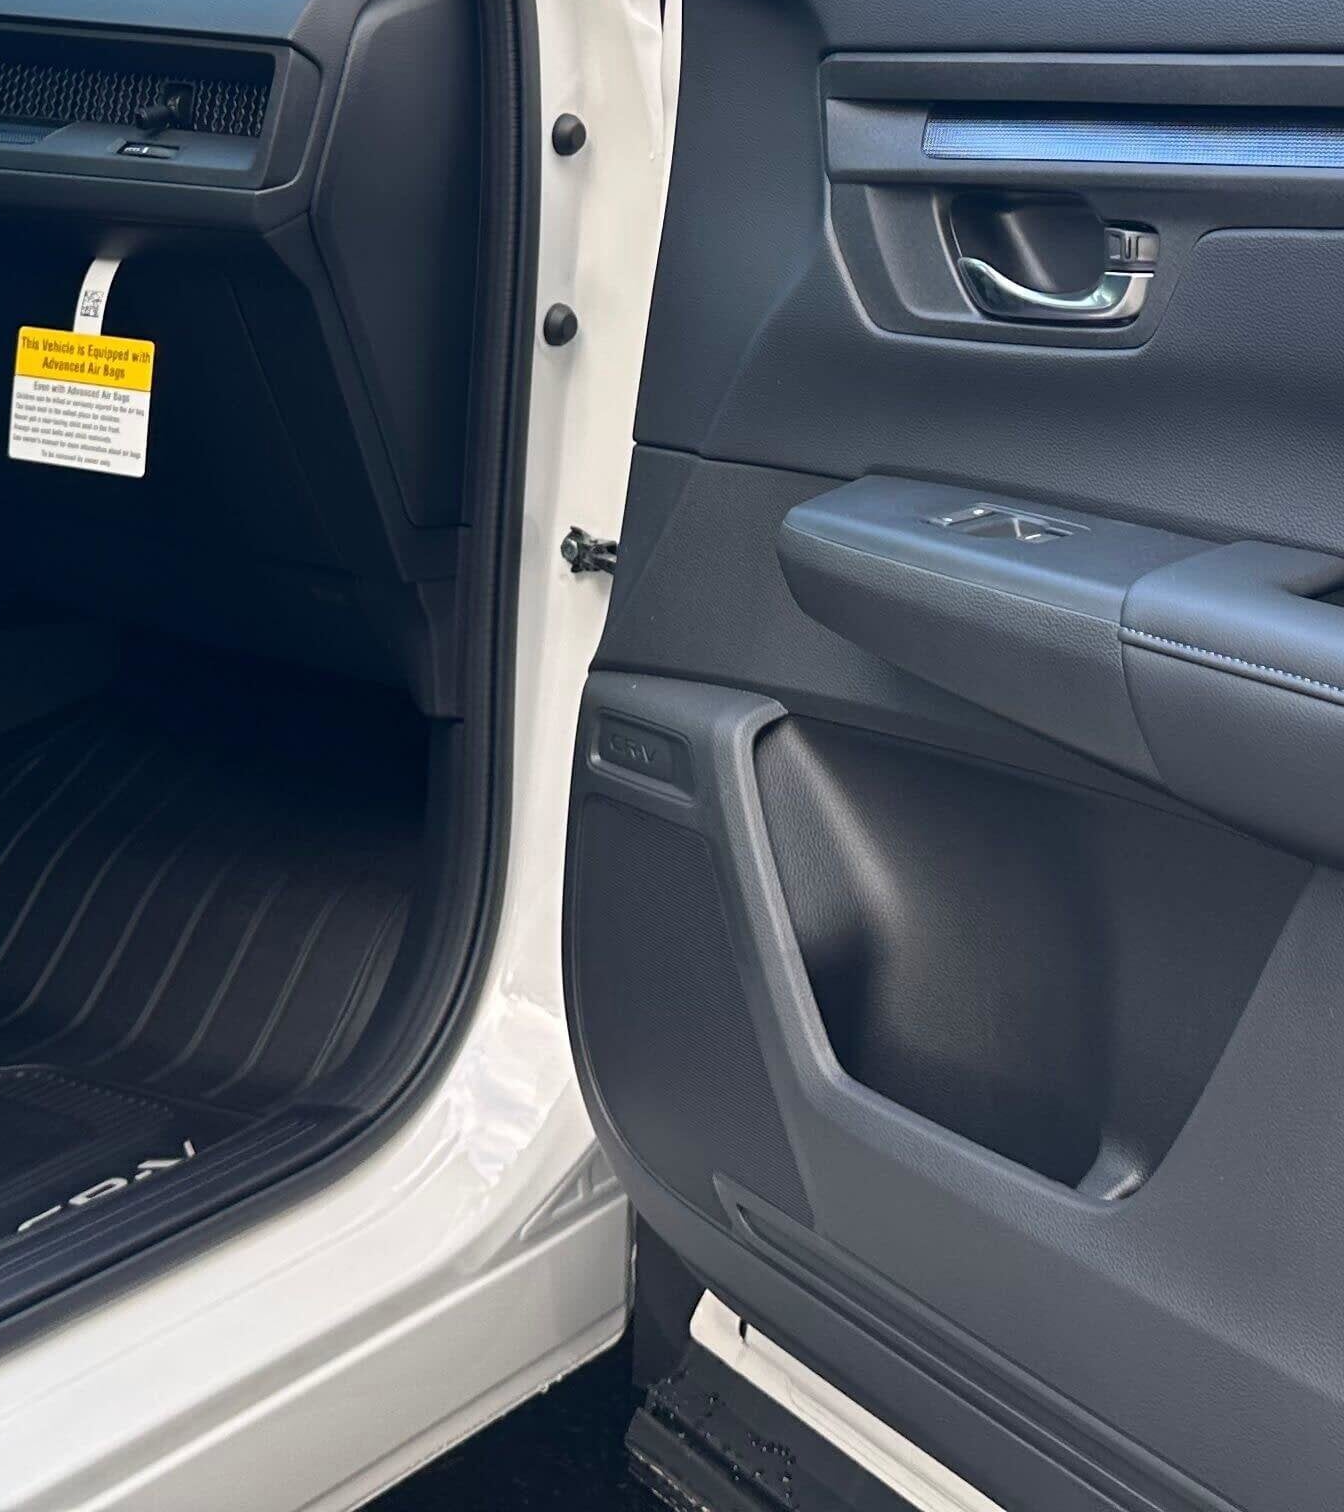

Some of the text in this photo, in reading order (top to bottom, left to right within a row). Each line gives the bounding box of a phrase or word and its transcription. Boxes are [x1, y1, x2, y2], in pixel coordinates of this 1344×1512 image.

[22, 336, 151, 364] This Vehicle is Equipped with
[41, 356, 126, 381] Advanced Air Bags
